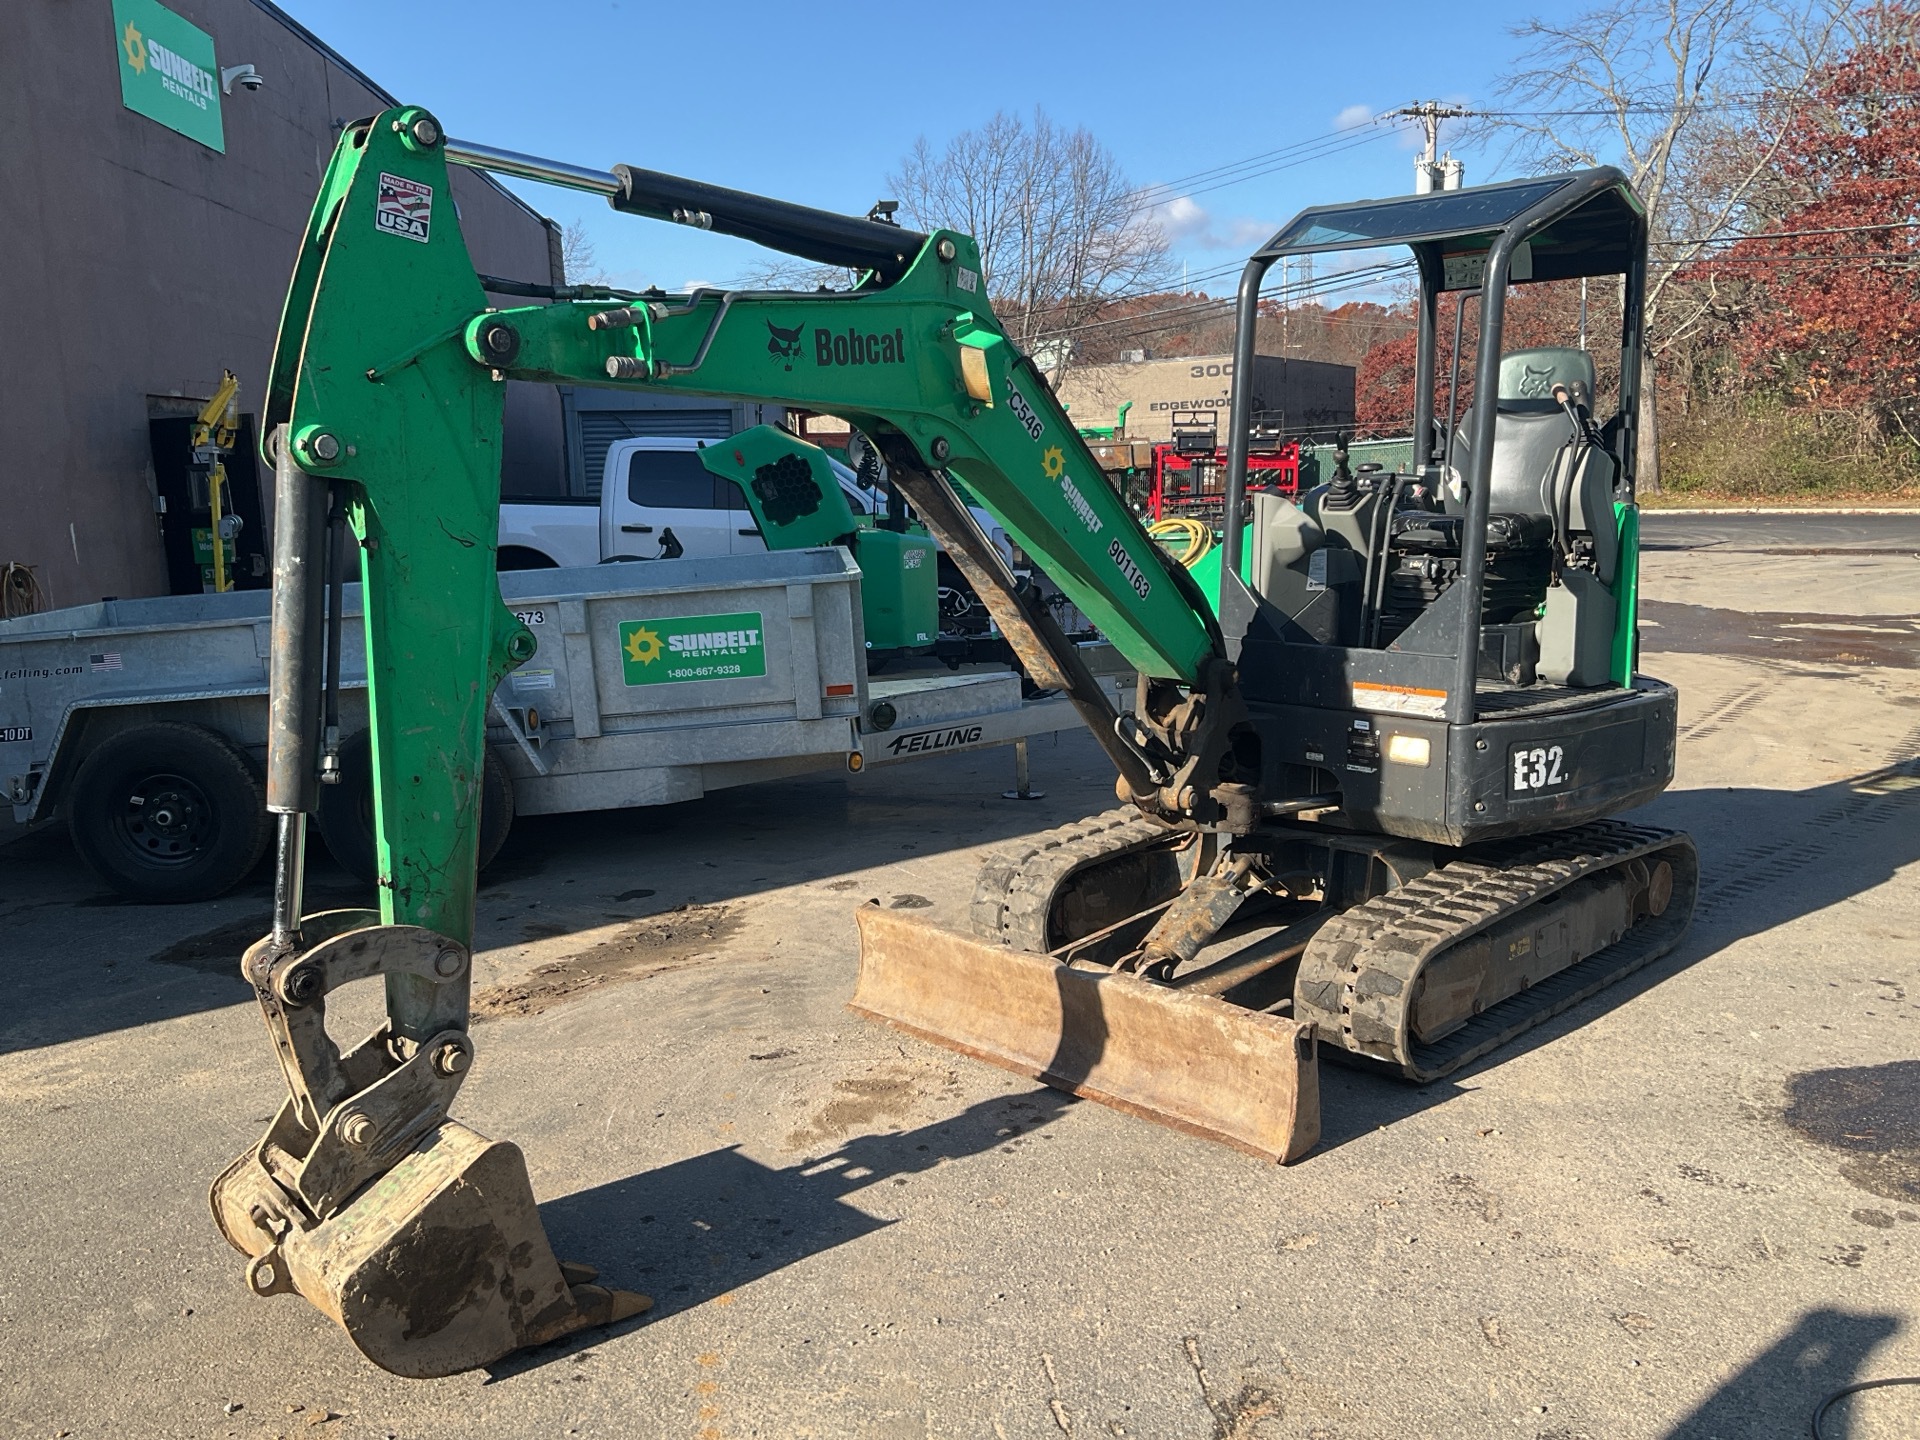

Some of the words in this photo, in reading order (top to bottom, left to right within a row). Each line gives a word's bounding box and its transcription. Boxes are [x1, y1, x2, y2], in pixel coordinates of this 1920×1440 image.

[147, 38, 214, 101] SUNBELT
[161, 75, 207, 110] RENTALS
[383, 176, 404, 188] MADE
[415, 186, 429, 195] THE
[380, 212, 425, 236] USA
[814, 327, 905, 367] Bobcat
[1061, 475, 1104, 534] SUNBELT
[1063, 492, 1092, 533] RENTALS
[1109, 540, 1150, 599] 901163
[516, 610, 544, 625] 673
[668, 629, 759, 652] SUNBELT
[916, 632, 929, 642] RL
[682, 647, 747, 658] RENTALS
[667, 664, 741, 679] 1-800-667-9328
[17, 727, 31, 740] DT
[886, 726, 983, 756] FELLING
[1513, 745, 1564, 791] E32
